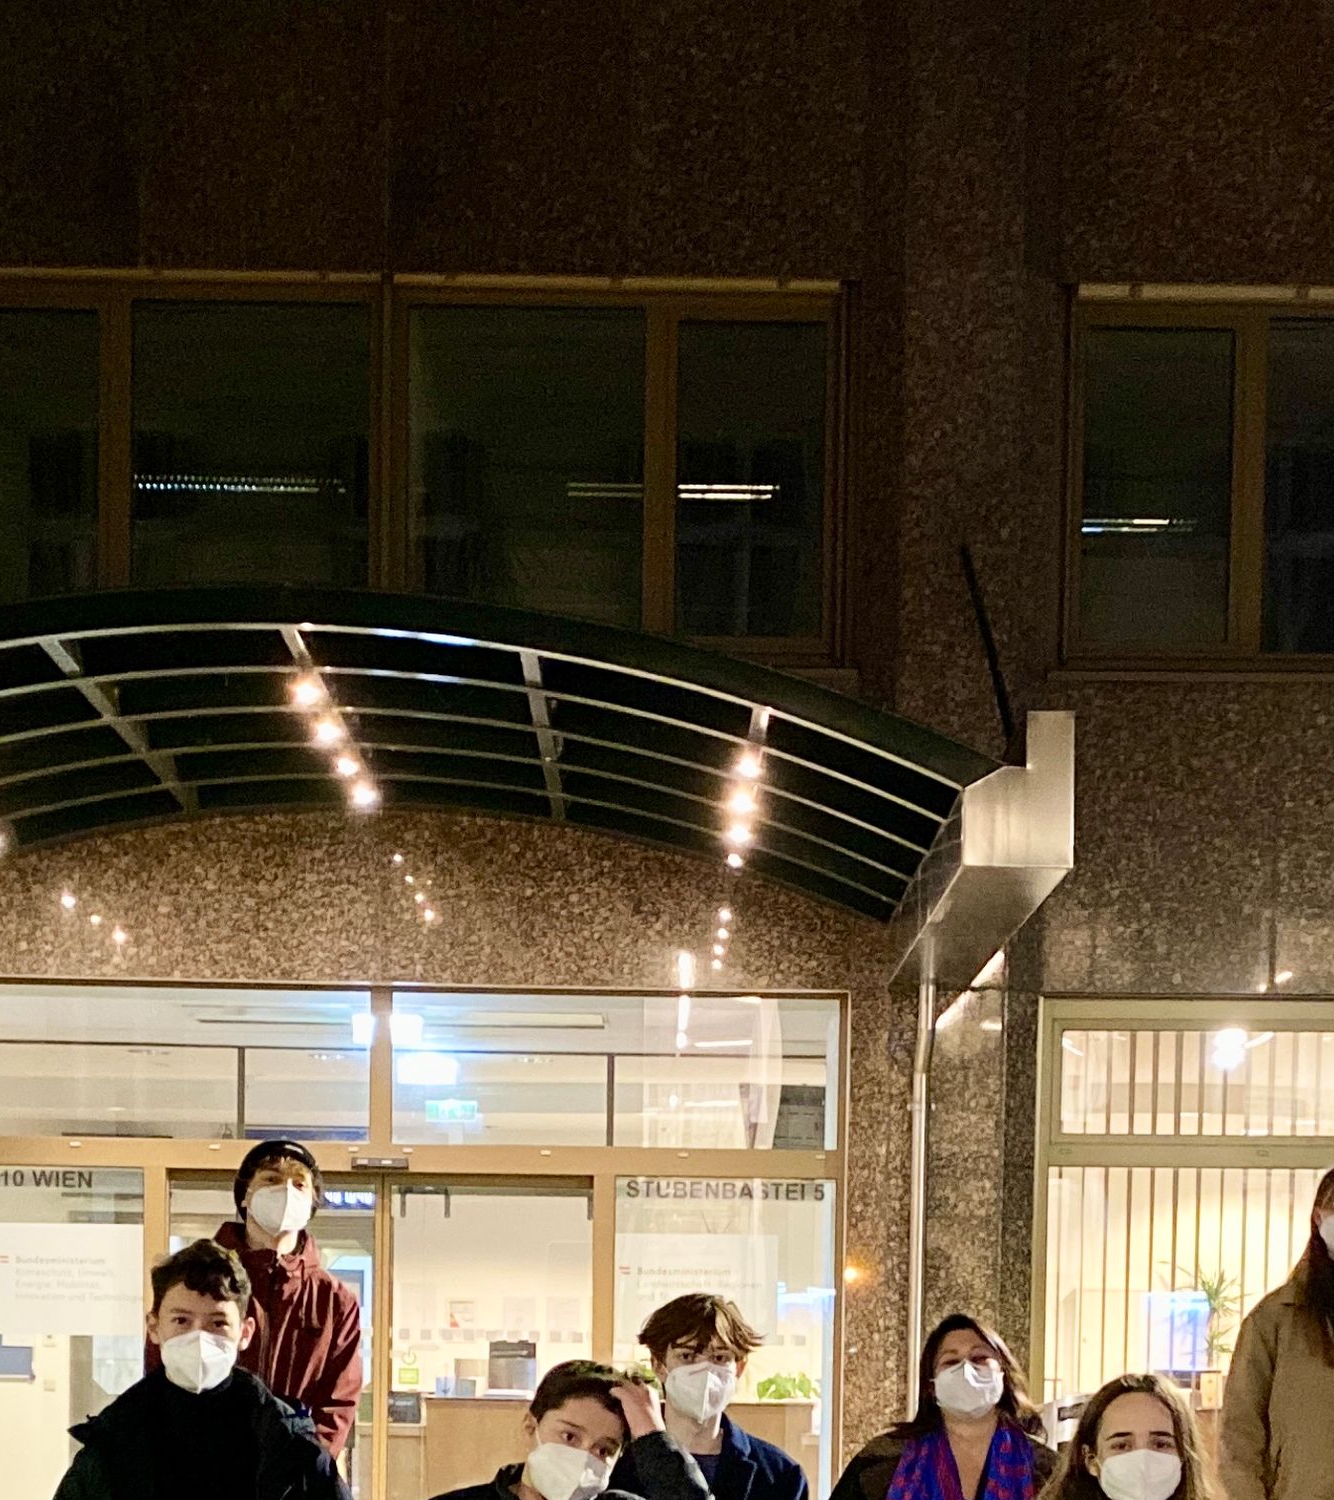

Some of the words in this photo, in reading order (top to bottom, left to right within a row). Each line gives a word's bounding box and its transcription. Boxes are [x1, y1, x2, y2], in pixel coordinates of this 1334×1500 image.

[31, 1170, 93, 1188] WIEN
[626, 1180, 806, 1201] STUBENBASTEI
[814, 1183, 825, 1201] 5
